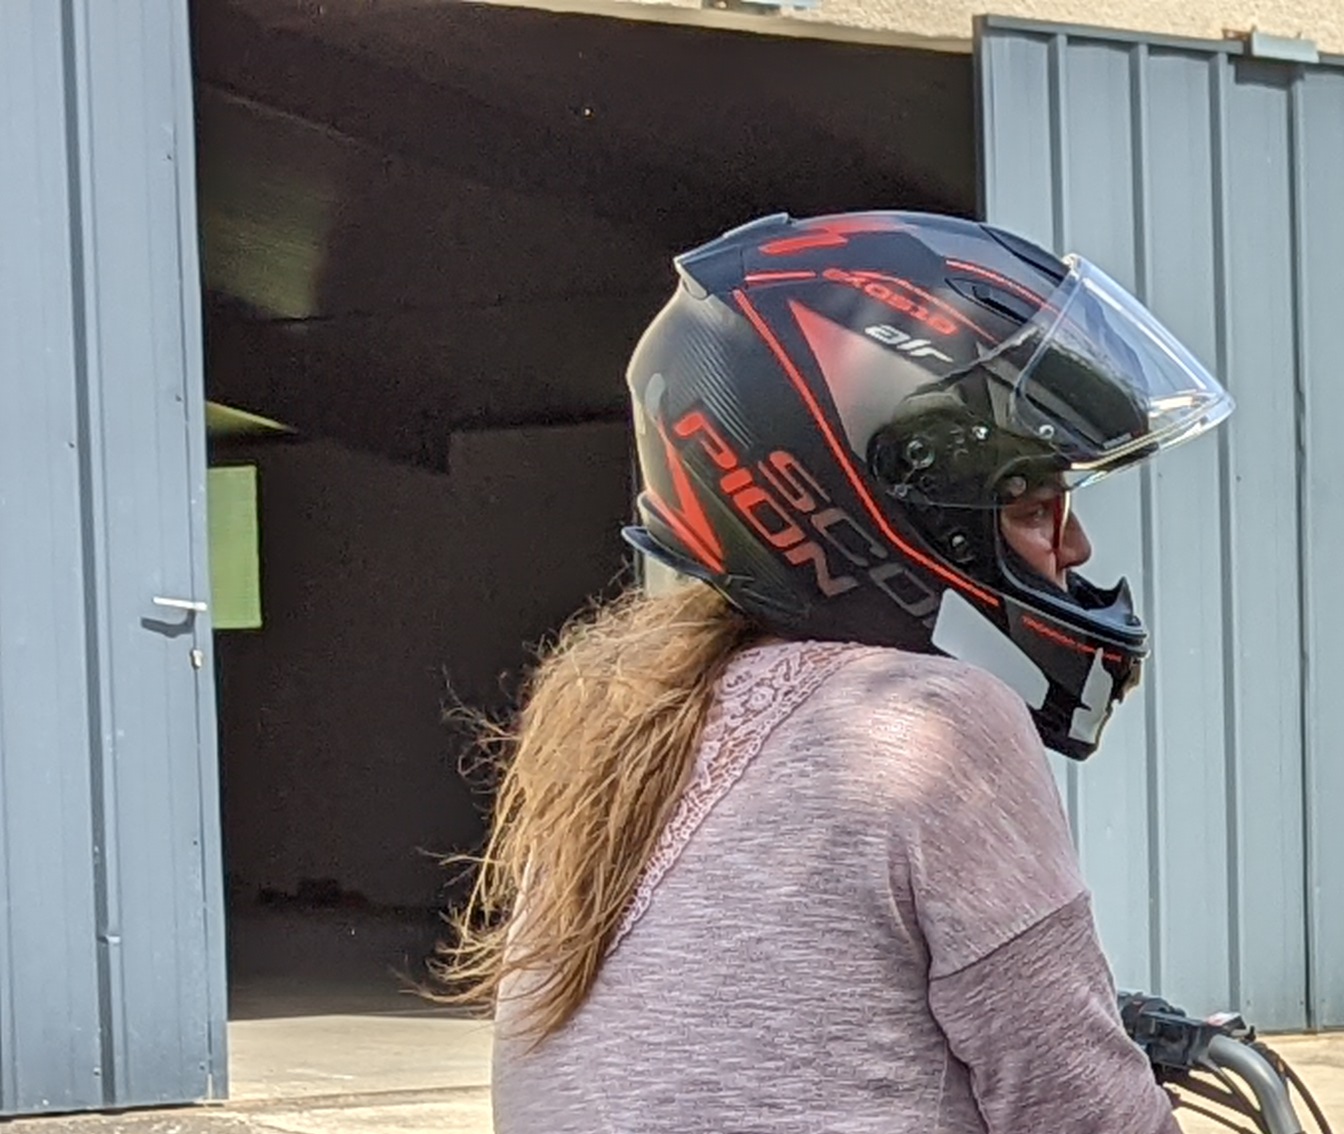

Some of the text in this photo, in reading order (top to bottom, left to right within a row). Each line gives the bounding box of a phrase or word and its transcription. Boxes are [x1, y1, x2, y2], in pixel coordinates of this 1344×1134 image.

[864, 324, 954, 362] air
[674, 411, 858, 597] PION
[758, 449, 938, 617] SCO
